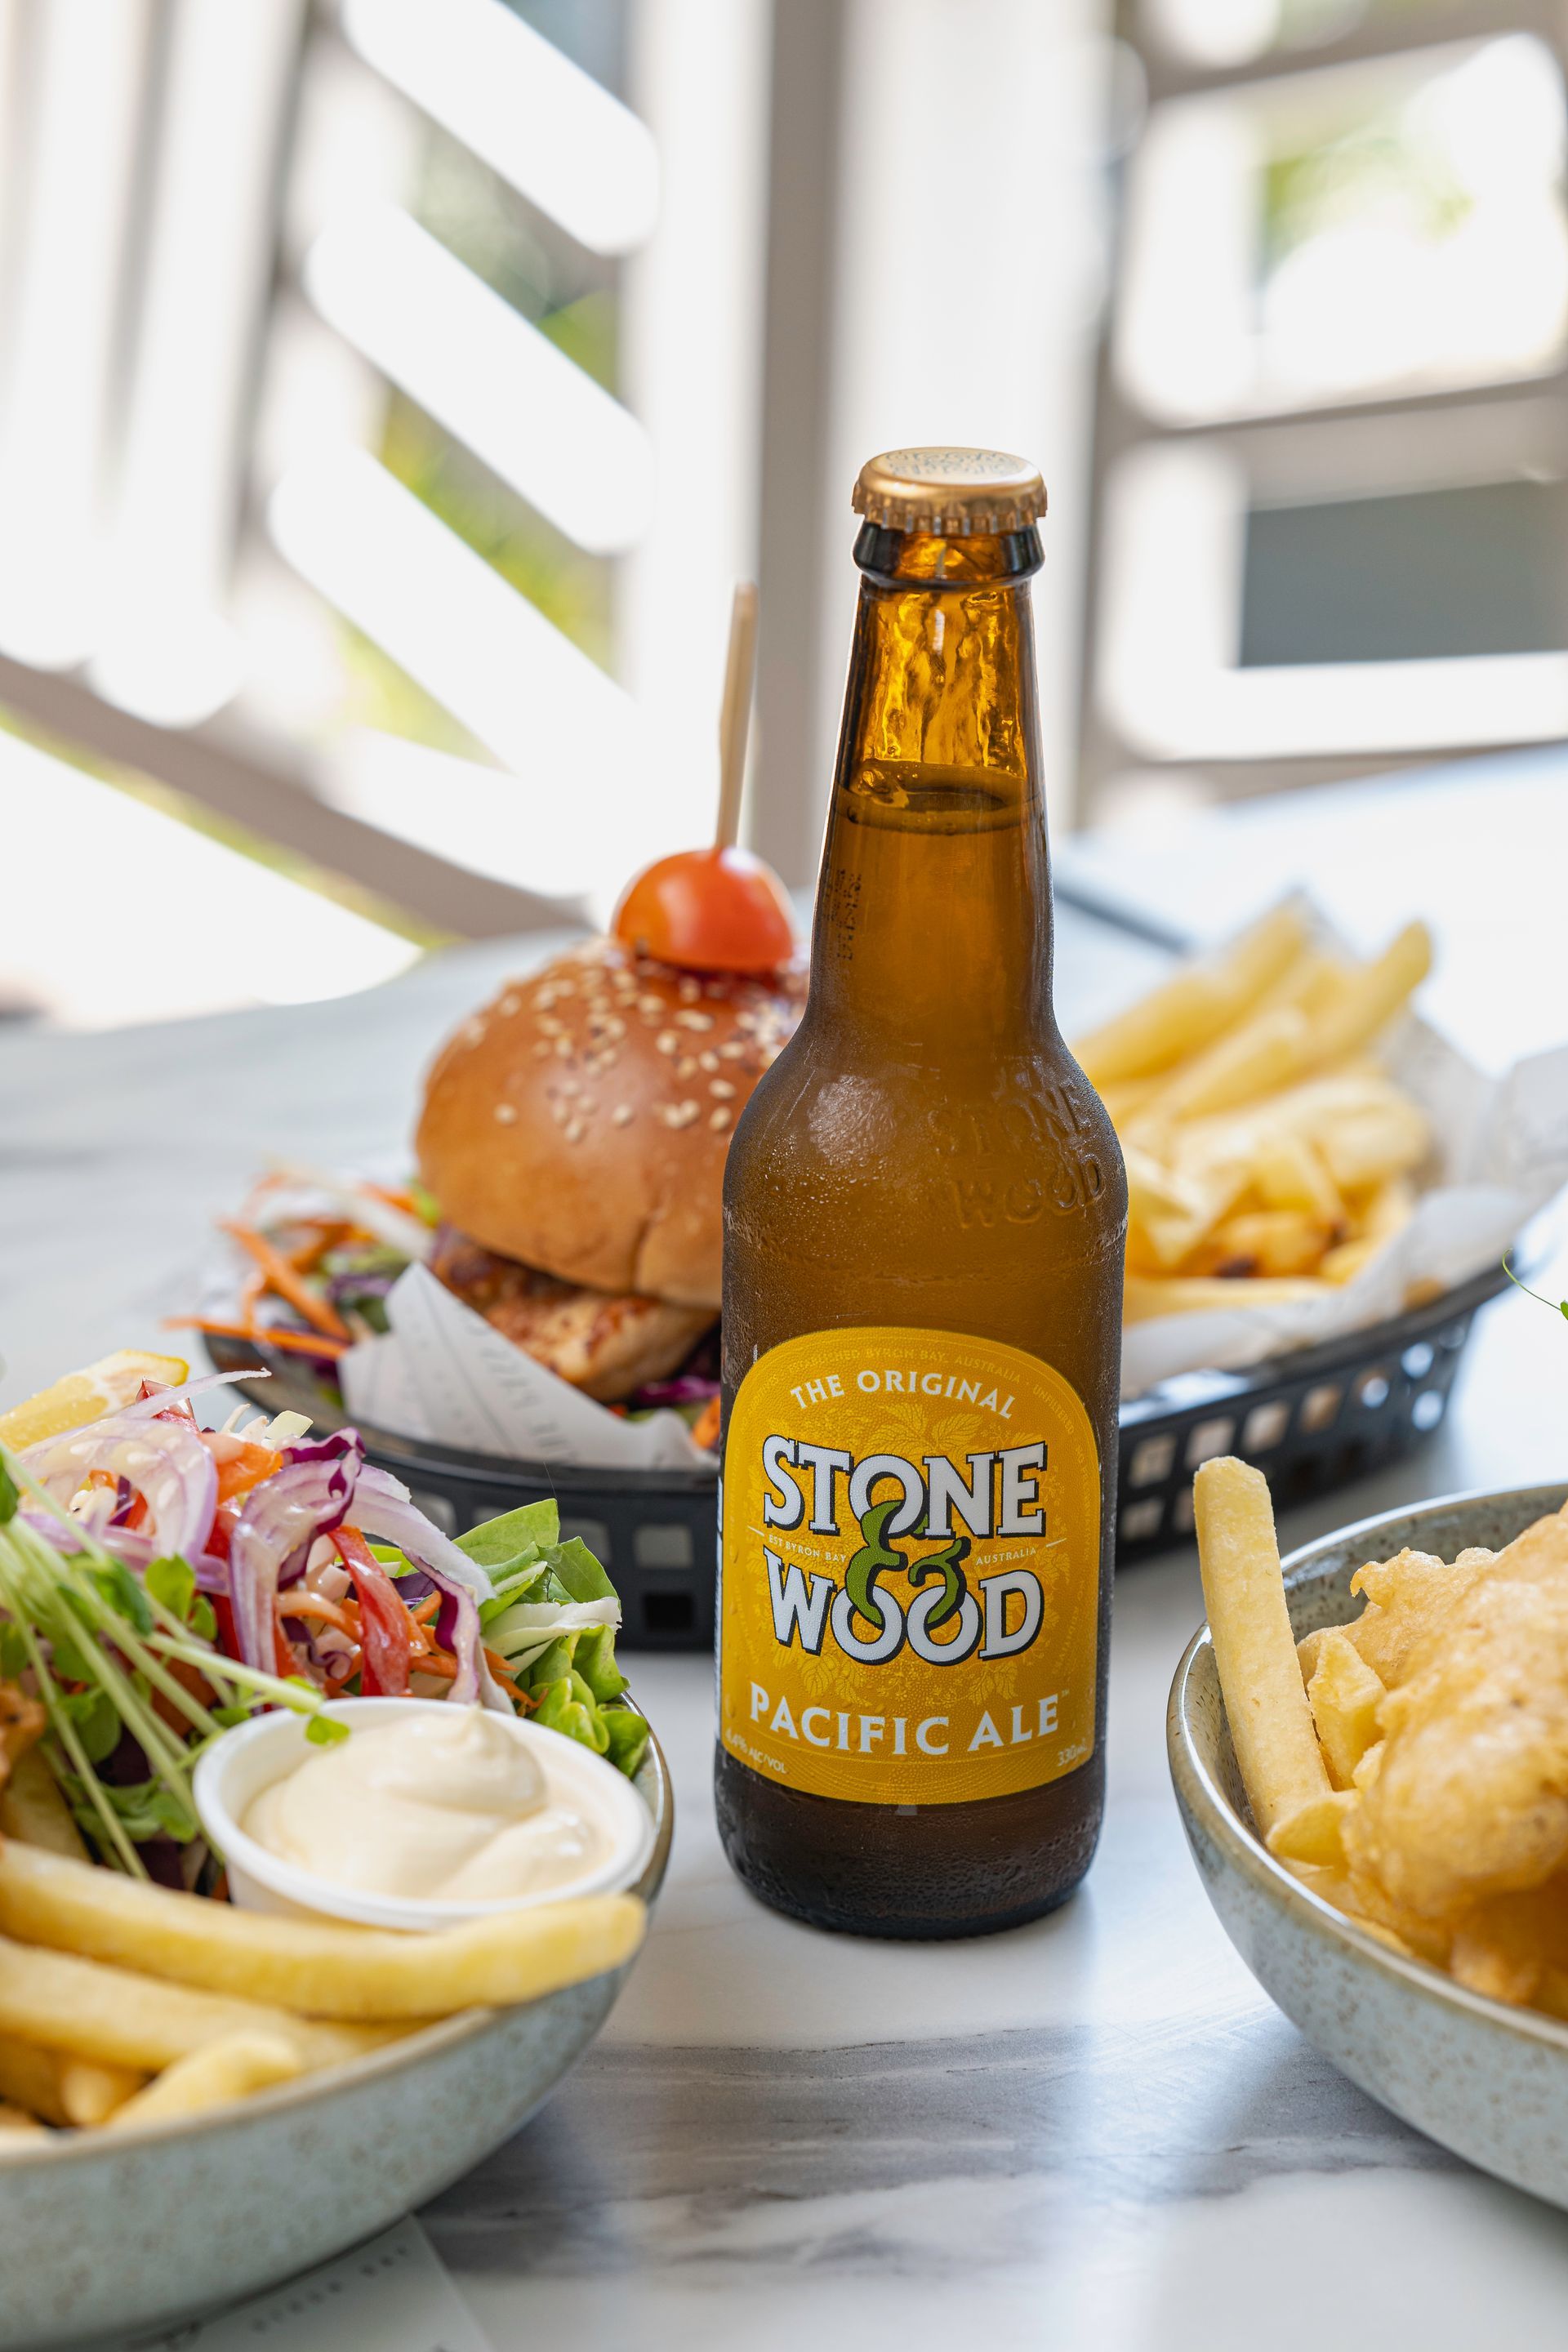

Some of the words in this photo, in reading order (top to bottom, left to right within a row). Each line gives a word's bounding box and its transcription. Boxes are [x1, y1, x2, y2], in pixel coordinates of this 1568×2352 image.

[790, 1373, 845, 1410] THE
[857, 1370, 1016, 1420] ORIGINAL
[955, 1355, 1021, 1383] AUSTRALIA
[762, 1434, 1048, 1539] STONE
[768, 1533, 783, 1547] EST
[786, 1540, 821, 1557] BYRON
[824, 1551, 847, 1563] BAY
[975, 1547, 1036, 1566] AUSTRALIA
[762, 1545, 1045, 1668] WOOD
[750, 1682, 950, 1755] PACIFIC
[967, 1693, 1059, 1753] ALE
